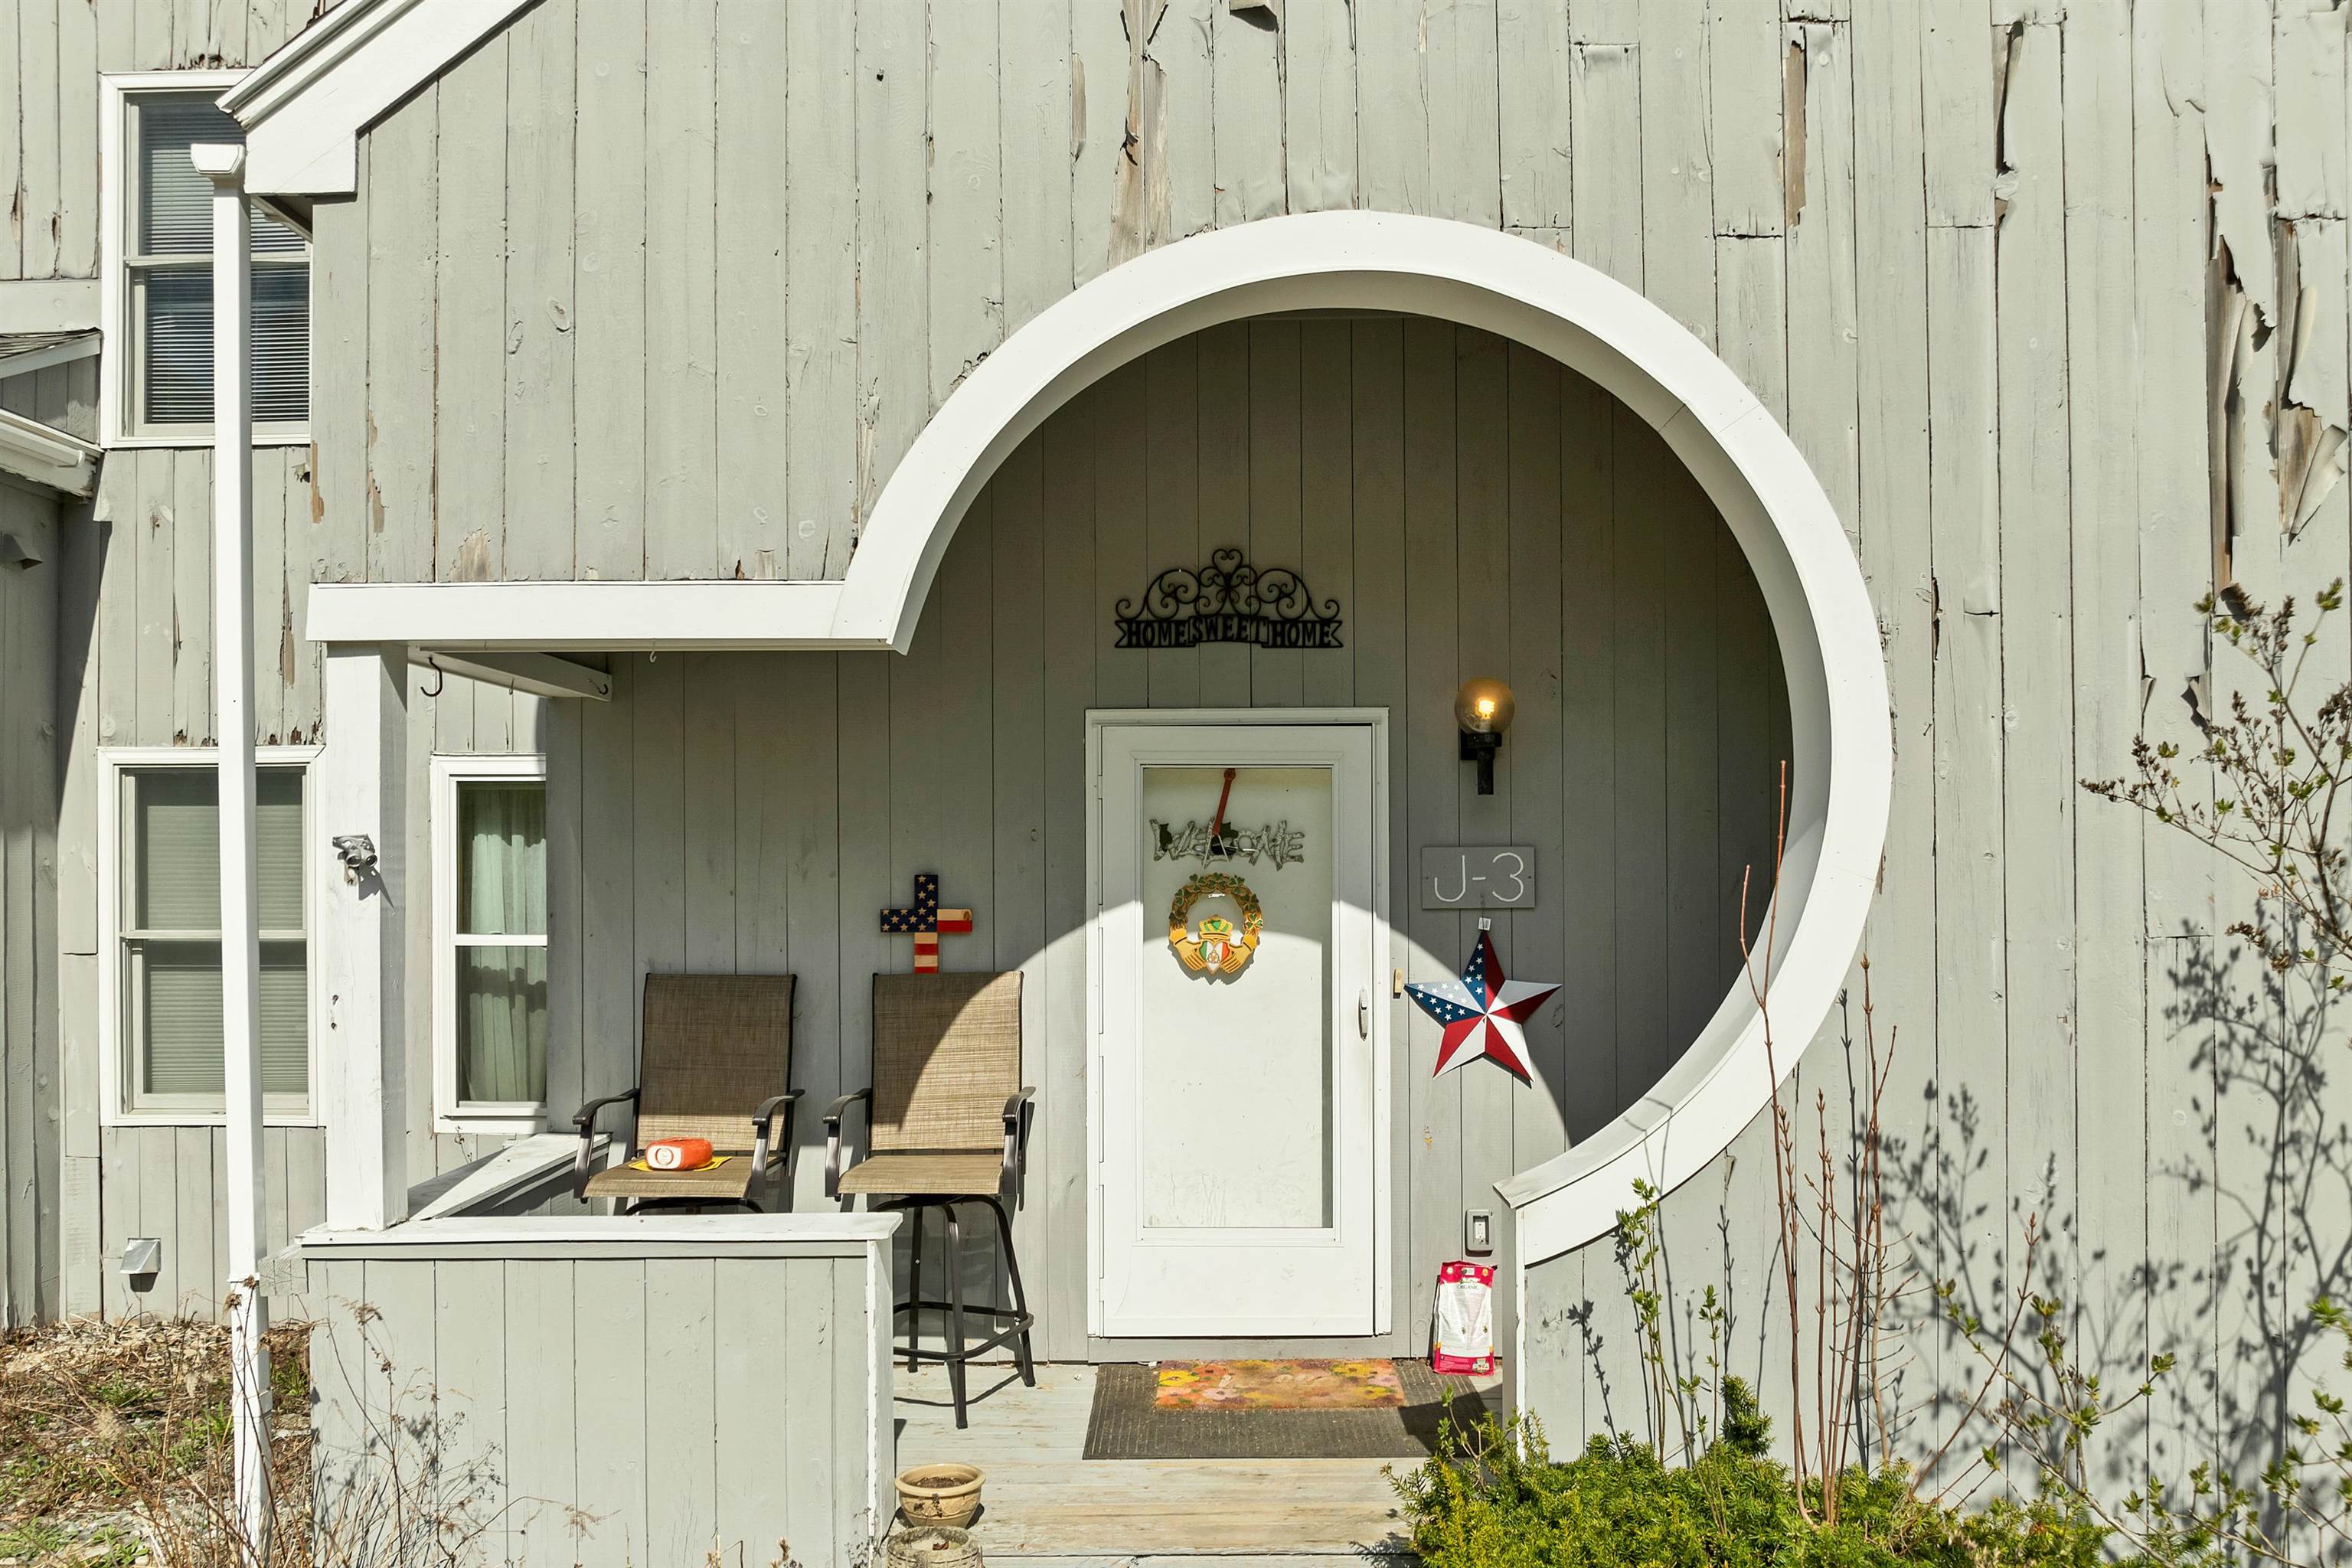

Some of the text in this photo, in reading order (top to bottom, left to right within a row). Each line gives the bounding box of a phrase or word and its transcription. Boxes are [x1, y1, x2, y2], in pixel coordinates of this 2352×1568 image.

[1126, 615, 1332, 647] HOME SWEET HOME
[1434, 852, 1524, 903] J-3
